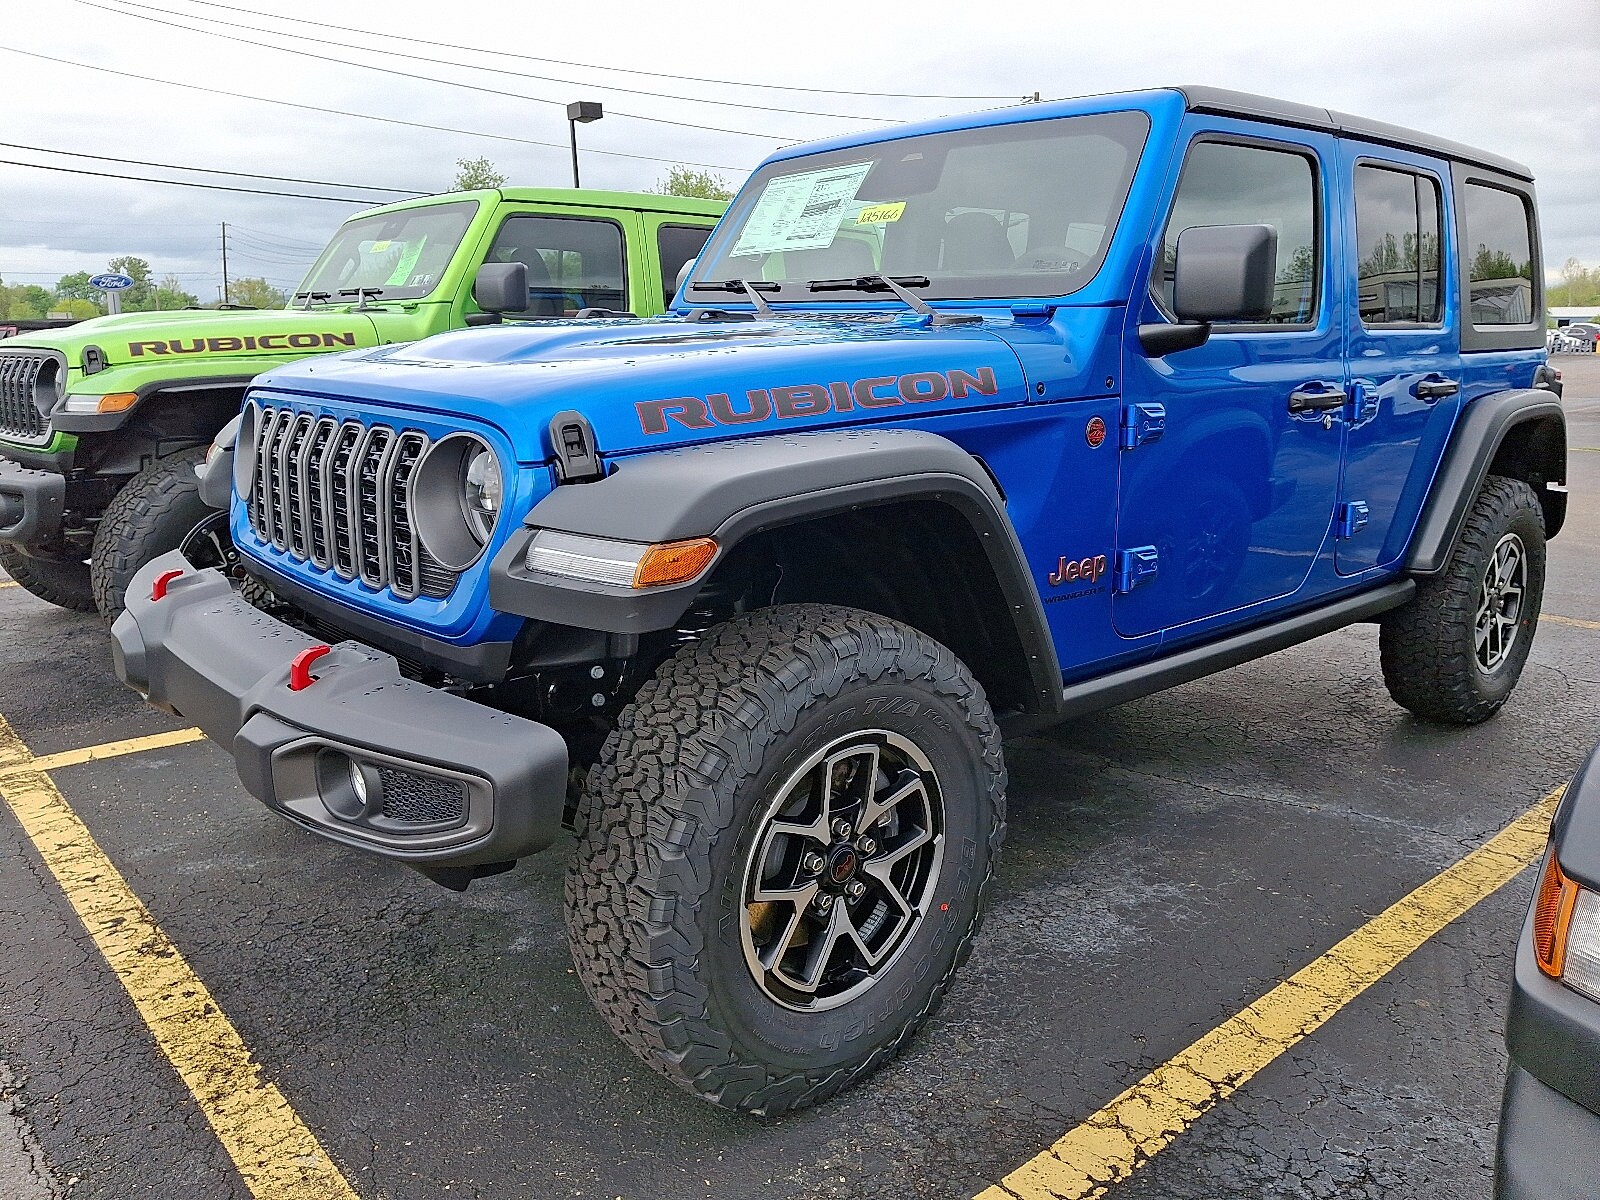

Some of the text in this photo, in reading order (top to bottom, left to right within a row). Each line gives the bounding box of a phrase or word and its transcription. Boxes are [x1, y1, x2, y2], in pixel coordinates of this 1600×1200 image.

[98, 276, 126, 287] Ford
[128, 332, 356, 357] RUBICON
[634, 366, 998, 435] RUBICON
[1048, 554, 1106, 585] Jeep
[1044, 588, 1097, 604] WRANGLER
